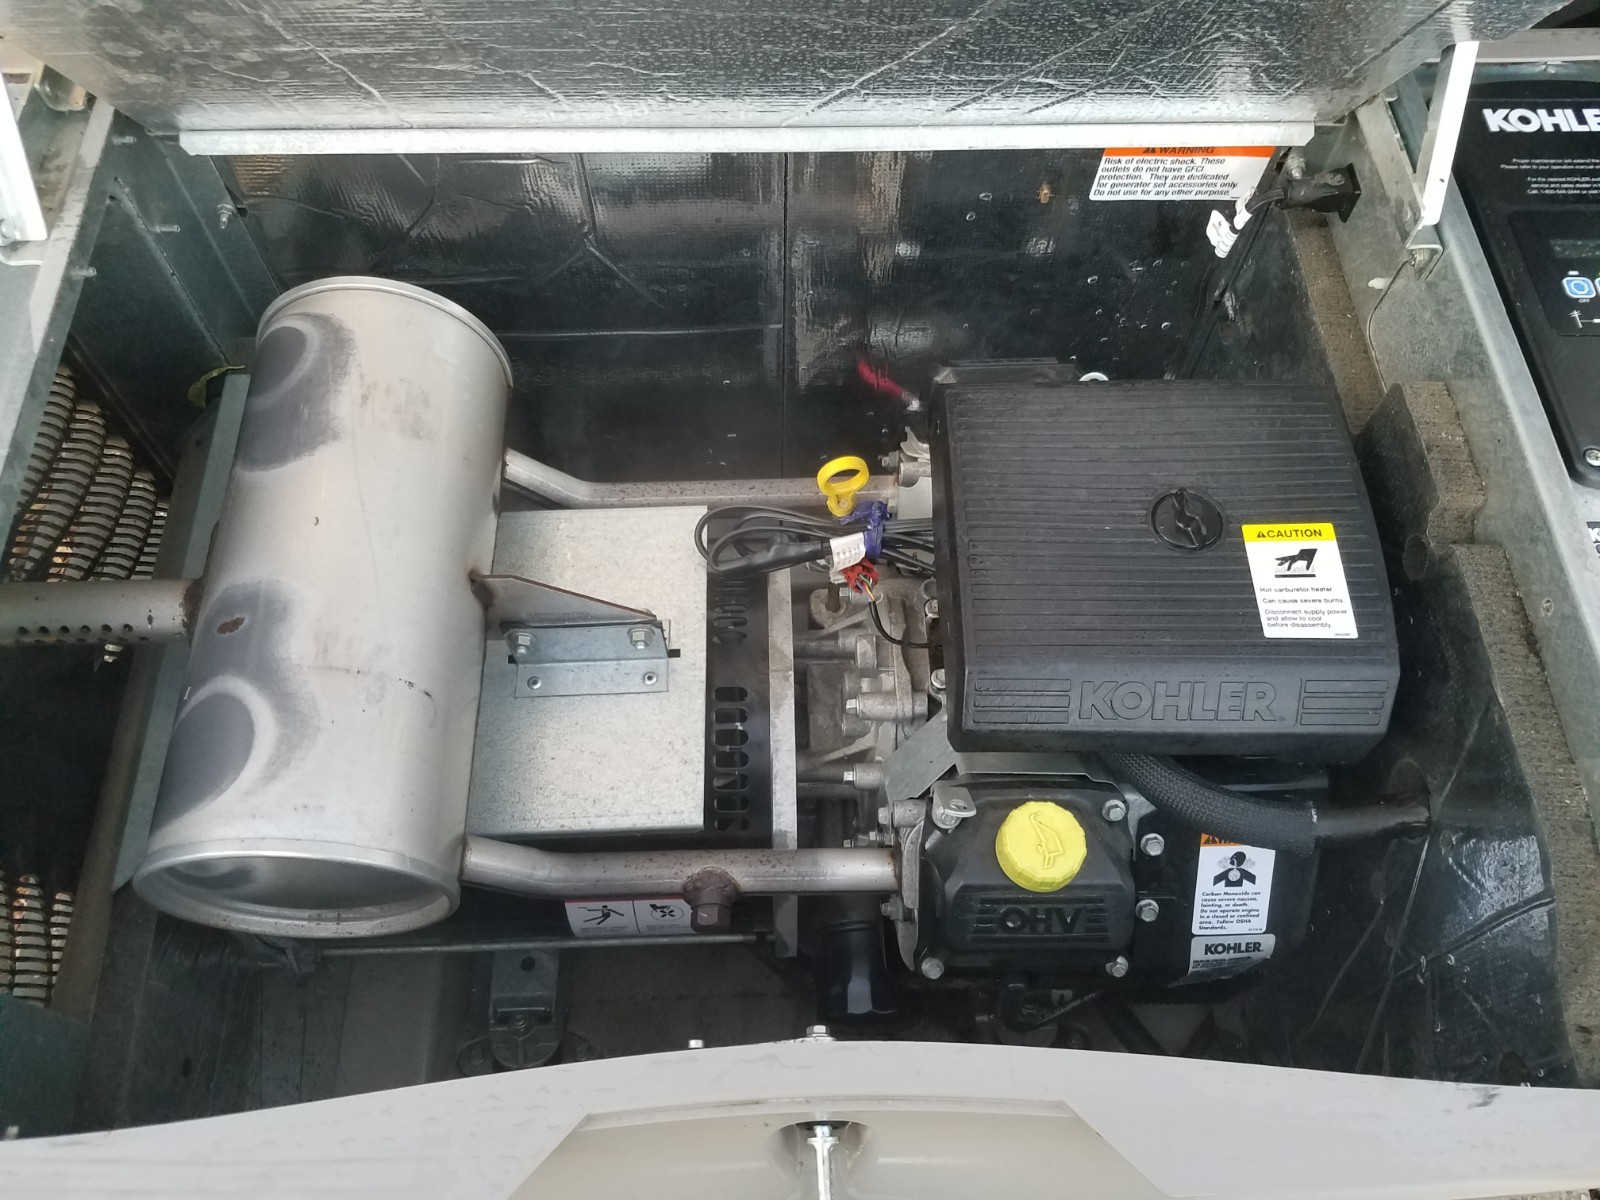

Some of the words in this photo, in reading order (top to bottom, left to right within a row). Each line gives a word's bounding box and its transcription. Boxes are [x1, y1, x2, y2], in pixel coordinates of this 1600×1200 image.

[1482, 108, 1600, 132] KOHLE
[1150, 174, 1169, 182] They
[1267, 529, 1322, 538] CAUTION
[1078, 680, 1277, 721] KOHLER
[1000, 906, 1083, 933] OHV
[1204, 942, 1262, 955] KOHLER
